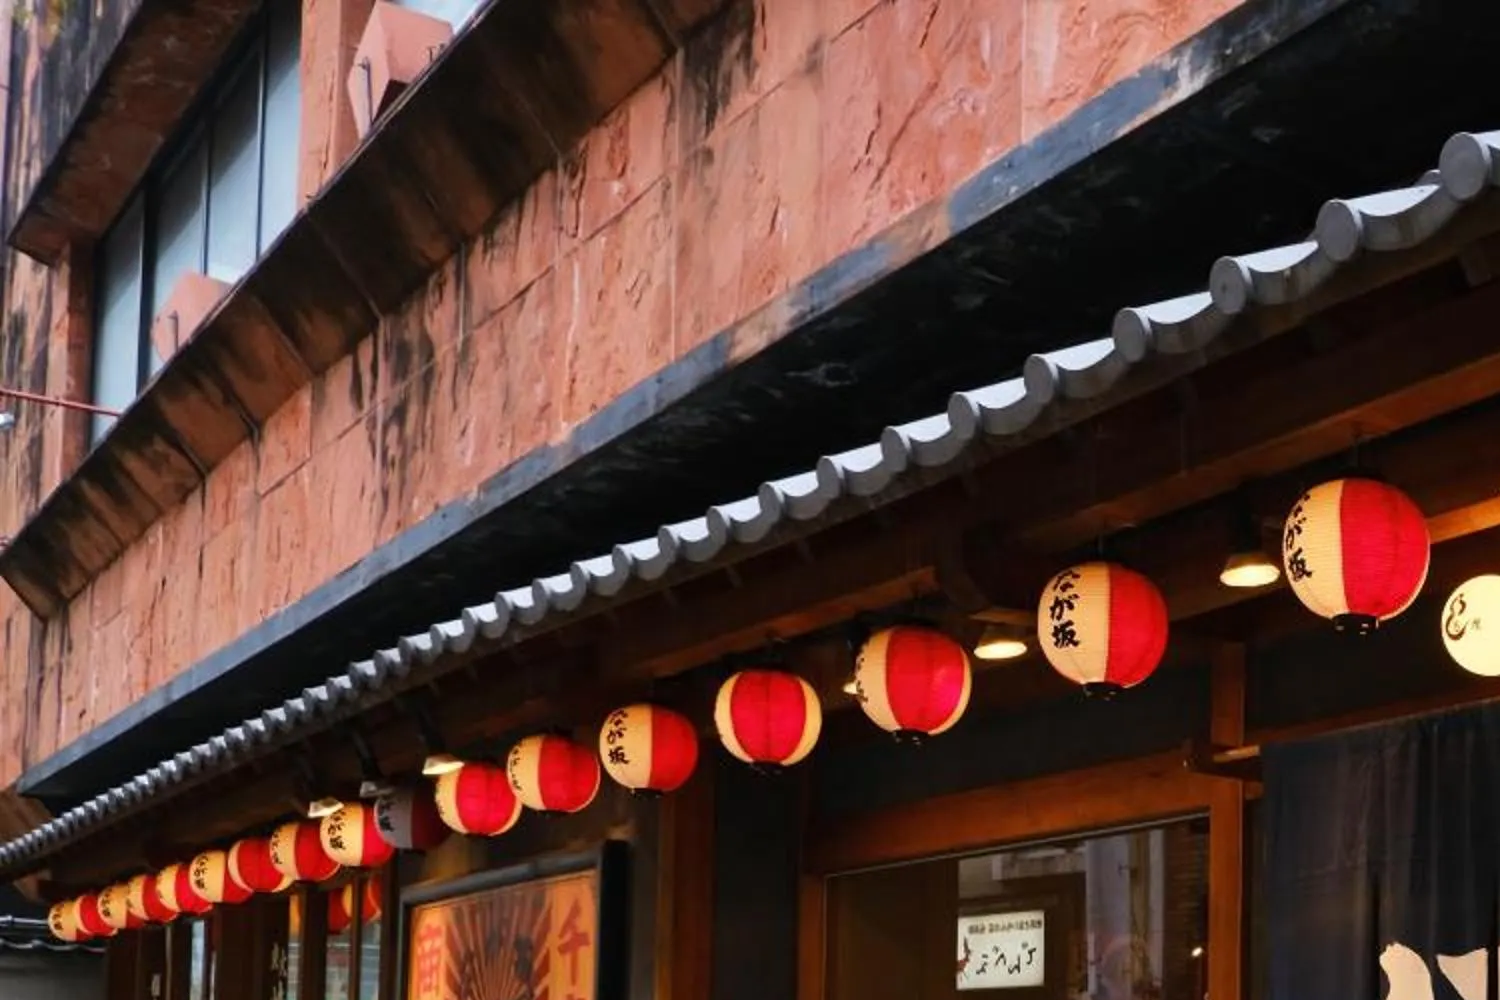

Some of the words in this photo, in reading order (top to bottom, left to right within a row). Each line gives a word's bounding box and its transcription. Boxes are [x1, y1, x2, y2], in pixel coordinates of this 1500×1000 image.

[1048, 566, 1082, 650] なが坂
[606, 709, 630, 766] なが坂
